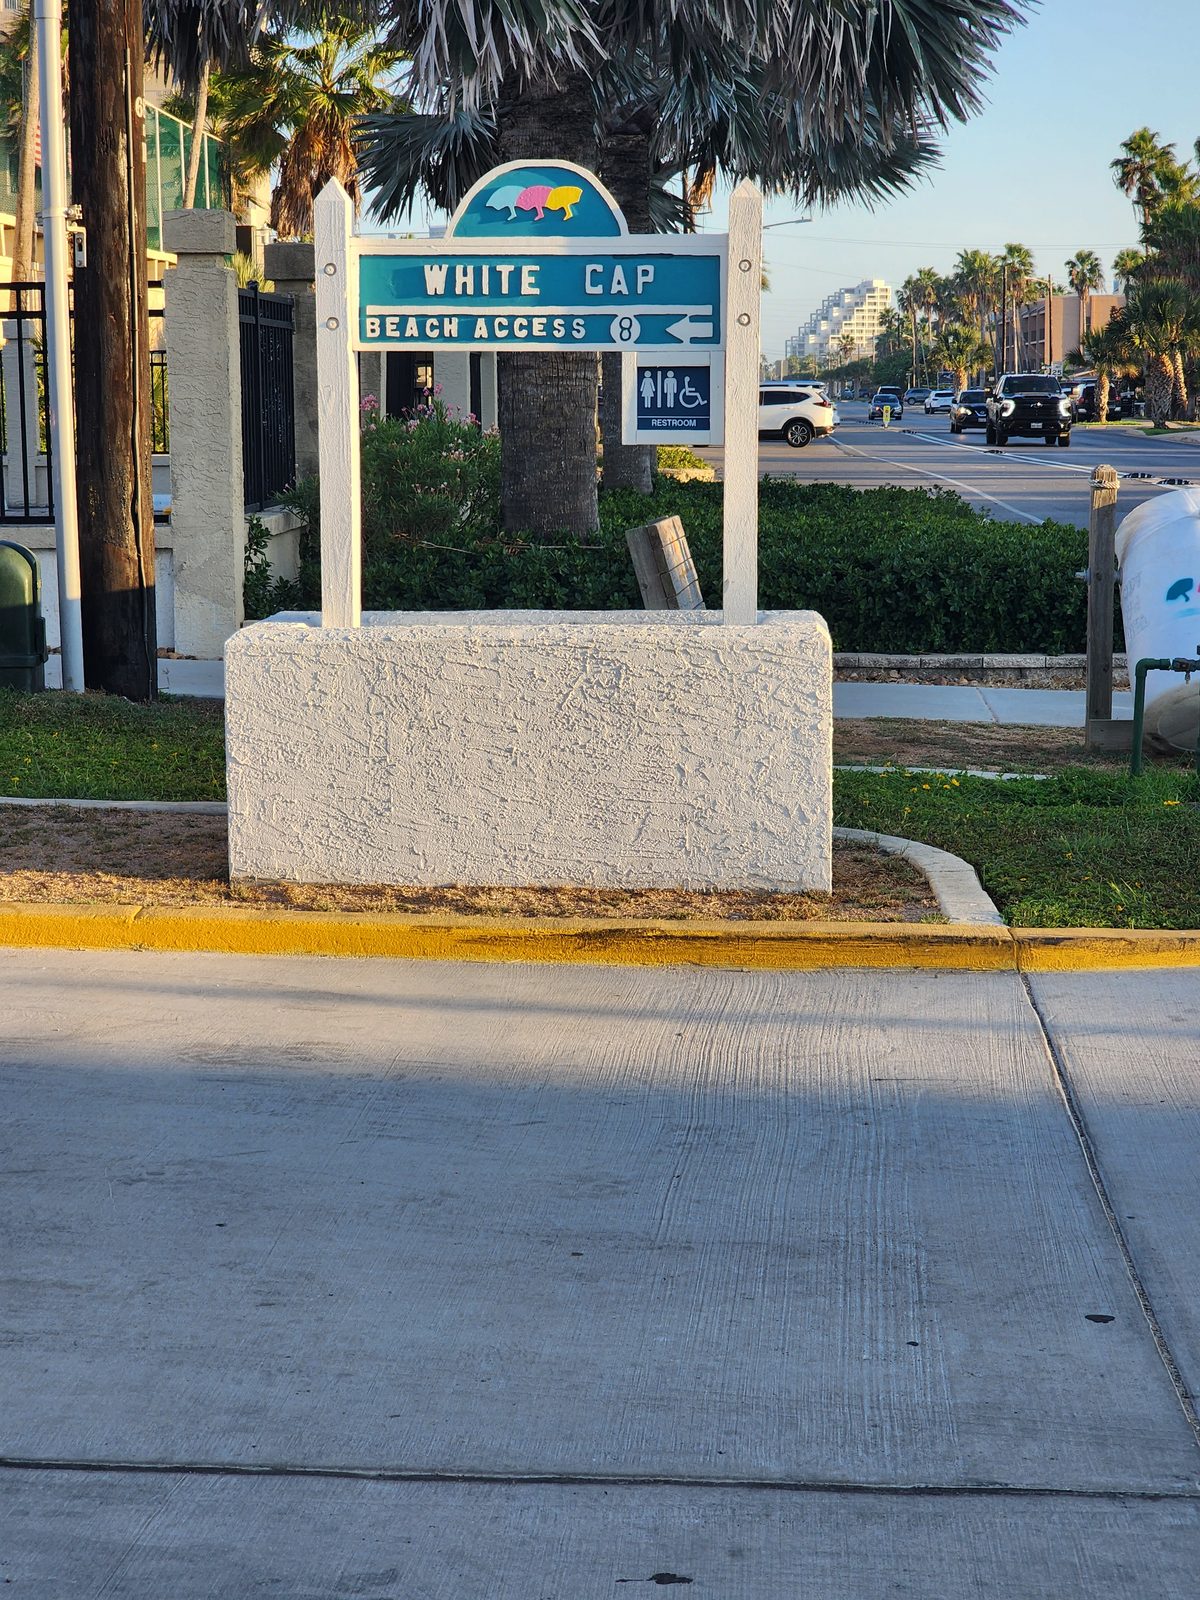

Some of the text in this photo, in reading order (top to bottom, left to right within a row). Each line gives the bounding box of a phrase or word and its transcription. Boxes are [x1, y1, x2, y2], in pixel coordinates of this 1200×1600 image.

[424, 264, 655, 295] WHITE CAP
[366, 316, 633, 342] BEACH ACCESS 8
[651, 419, 697, 427] RESTROOM
